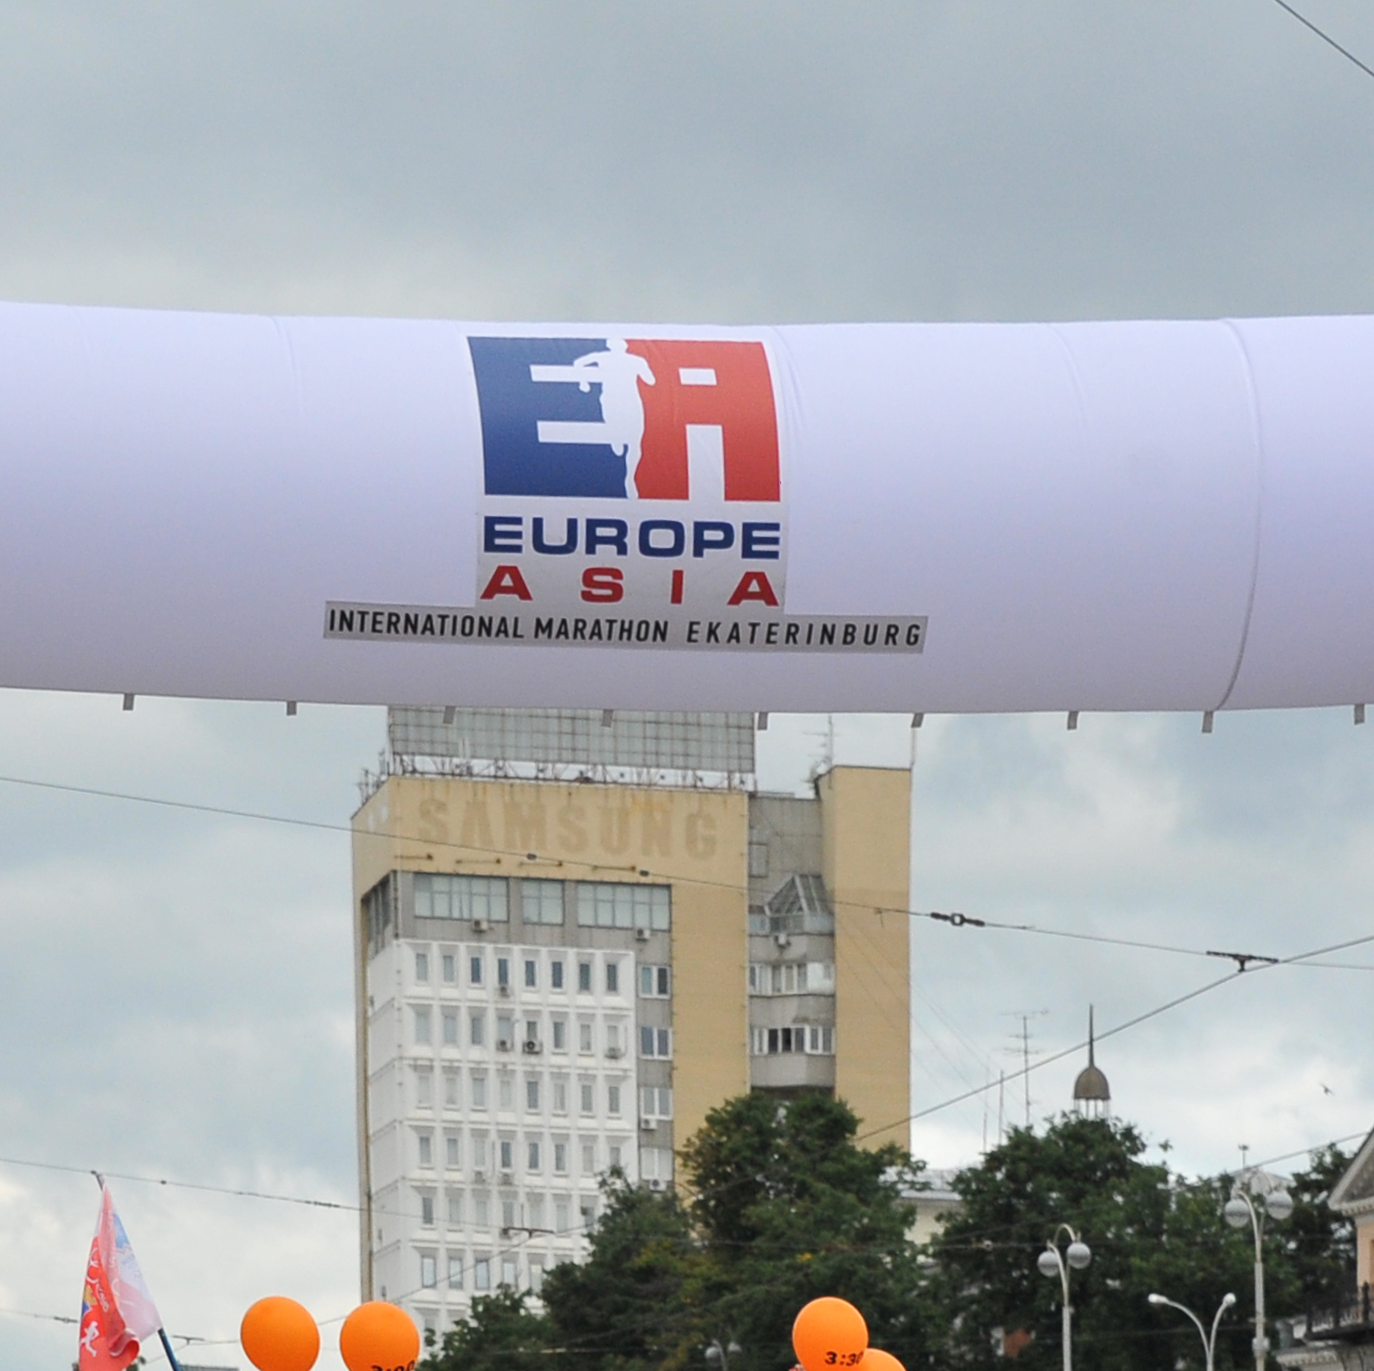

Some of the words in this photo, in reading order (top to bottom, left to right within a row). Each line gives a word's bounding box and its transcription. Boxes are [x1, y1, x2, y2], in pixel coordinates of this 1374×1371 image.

[483, 516, 781, 560] EUROPE
[480, 565, 779, 606] ASIA
[329, 609, 525, 641] INTERNATIONAL
[533, 617, 669, 645] MARATHON
[686, 620, 922, 648] EKATERINBURG
[417, 800, 718, 861] SAMSUNG
